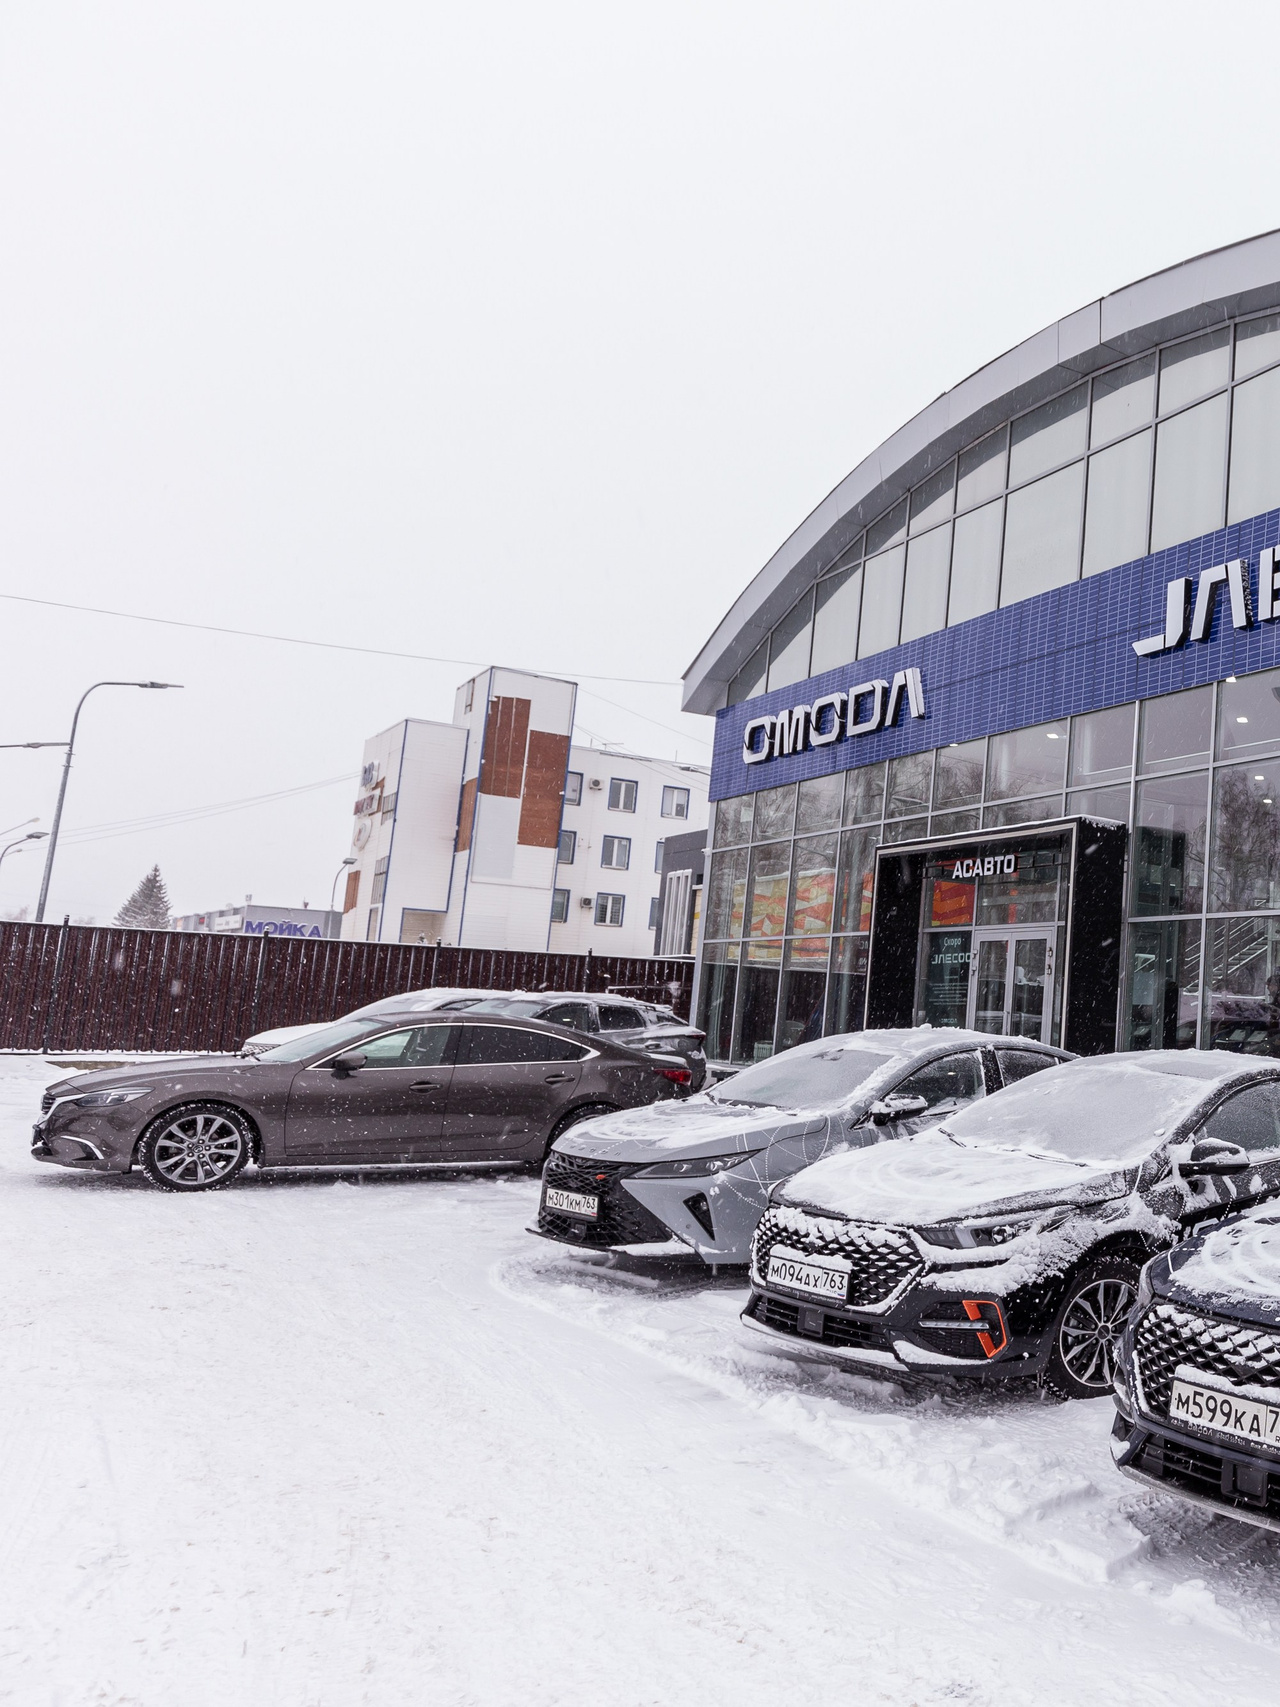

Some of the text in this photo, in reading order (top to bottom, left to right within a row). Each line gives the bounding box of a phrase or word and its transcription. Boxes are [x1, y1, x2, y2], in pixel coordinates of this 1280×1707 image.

[743, 667, 924, 764] OMODA
[952, 855, 1015, 879] АСАВТО
[244, 918, 322, 938] МОЙКА
[944, 937, 961, 947] Скоро
[548, 1191, 596, 1212] М301КМ 763
[770, 1262, 845, 1291] М094АХ 763
[1176, 1390, 1261, 1437] М599КА
